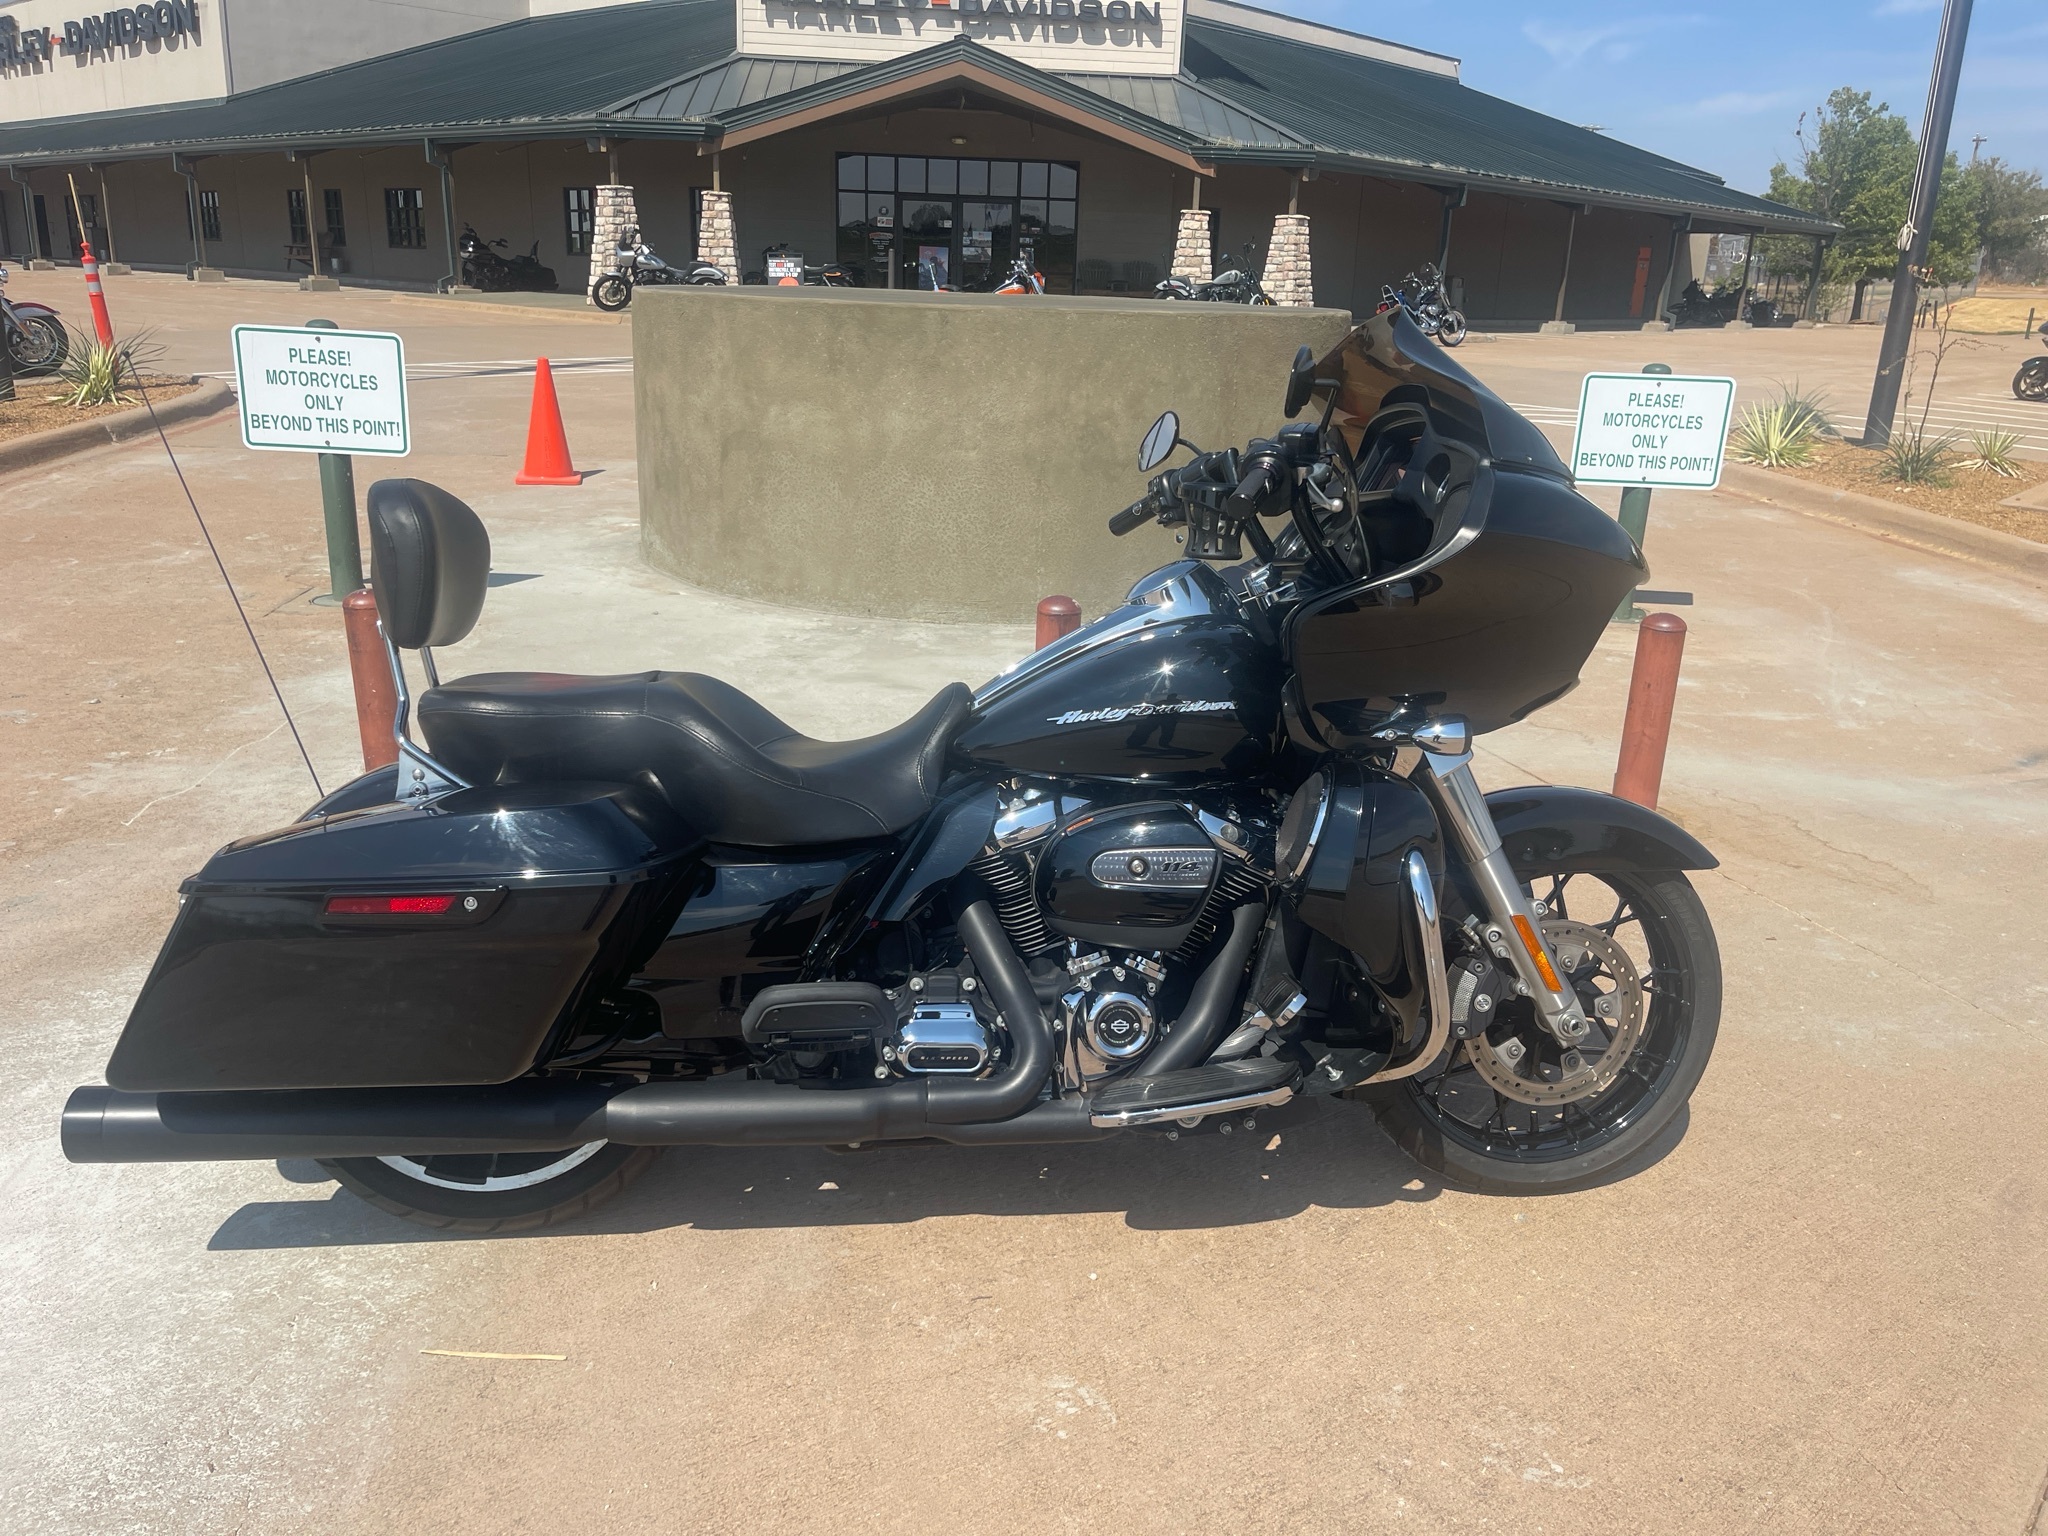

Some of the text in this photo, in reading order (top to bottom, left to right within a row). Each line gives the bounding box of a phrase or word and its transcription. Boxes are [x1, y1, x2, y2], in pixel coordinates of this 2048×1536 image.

[288, 347, 351, 366] PLEASE!
[265, 369, 378, 390] MOTORCYCLES
[304, 394, 344, 411] ONLY
[1628, 392, 1684, 408] PLEASE!
[250, 413, 400, 436] BEYOND THIS POINT!
[1602, 412, 1703, 429] MOTORCYCLES
[1631, 434, 1668, 449] ONLY
[1579, 452, 1714, 471] BEYOND THIS POINT!
[1047, 700, 1238, 724] Harley-Davidson
[1161, 860, 1201, 873] 114
